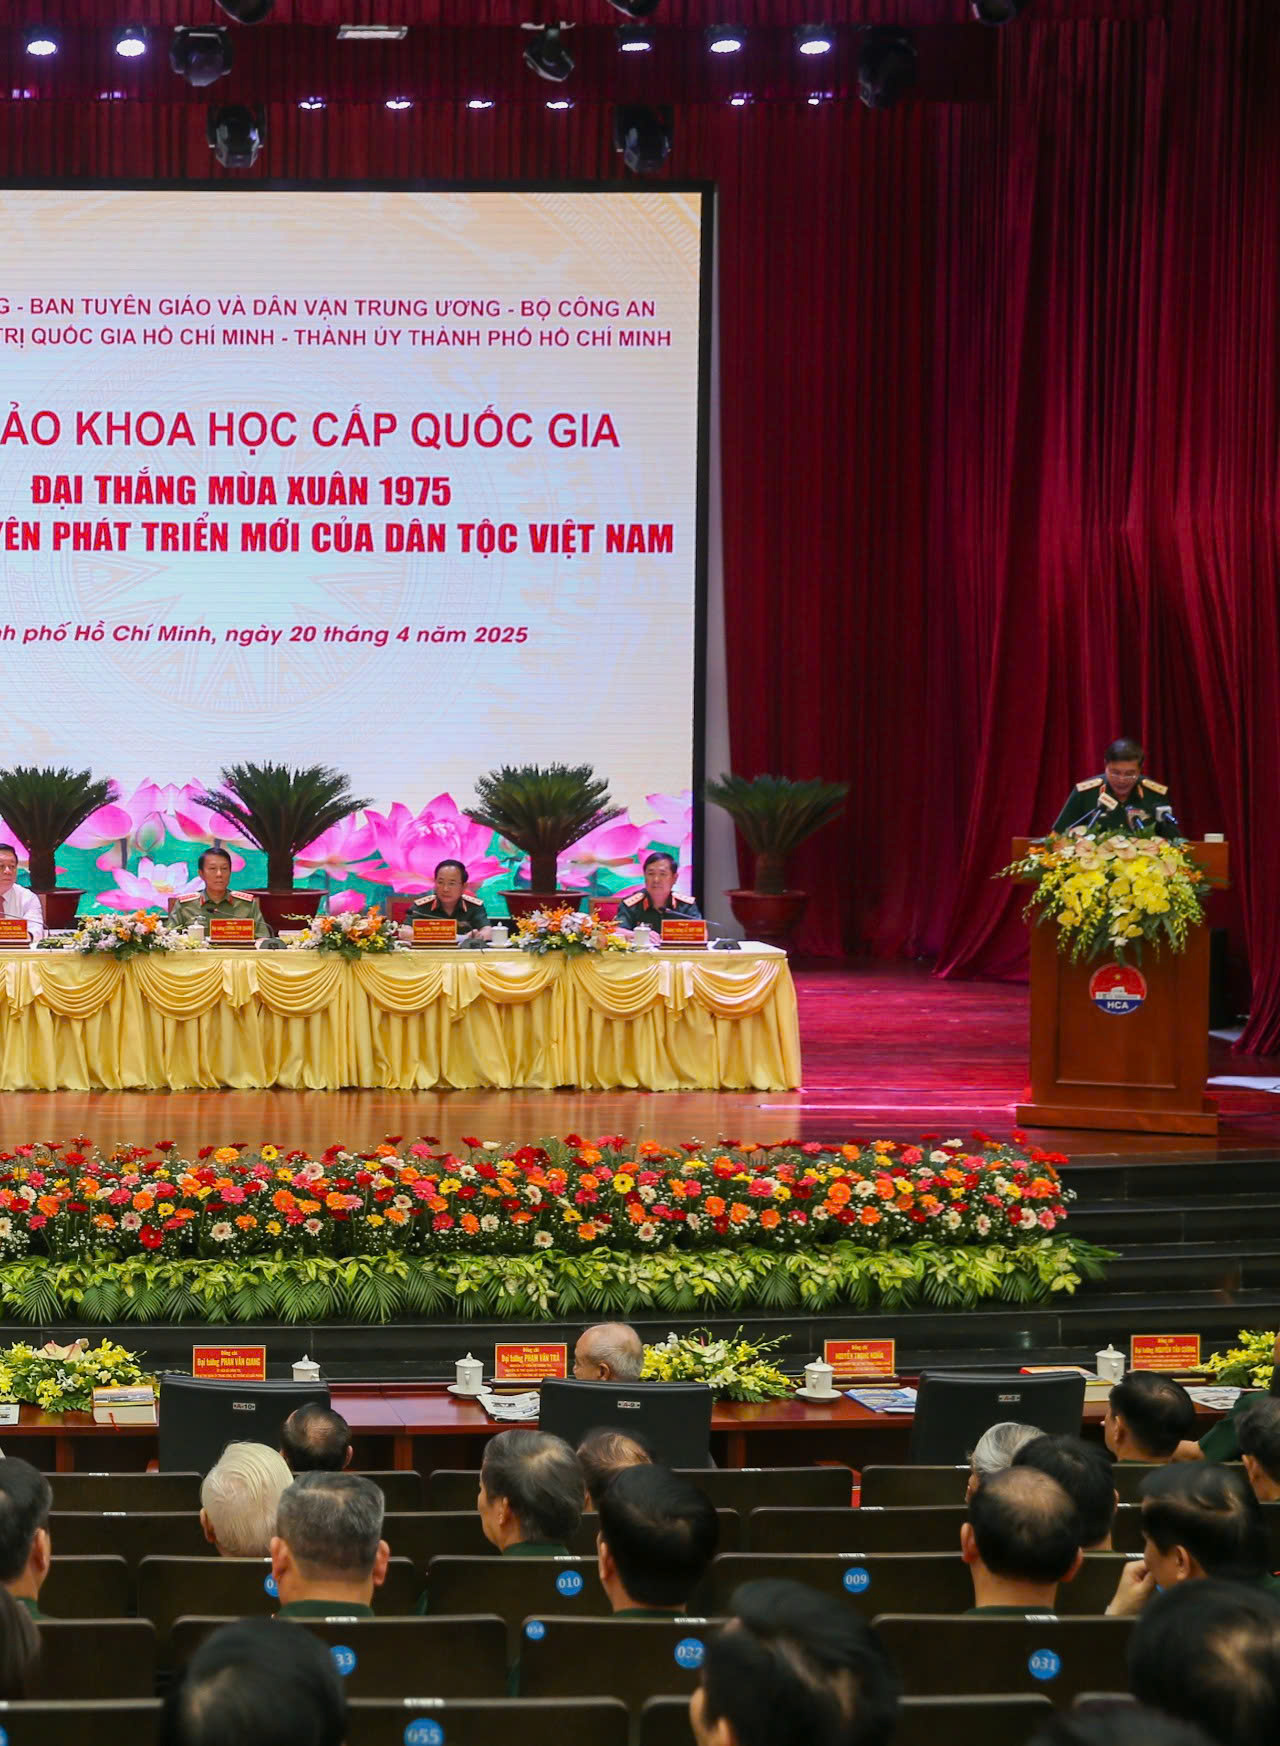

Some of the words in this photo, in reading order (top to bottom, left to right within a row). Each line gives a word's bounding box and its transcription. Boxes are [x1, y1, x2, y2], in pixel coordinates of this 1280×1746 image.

[31, 298, 73, 314] BAN
[81, 294, 150, 315] TUYÊN
[159, 295, 211, 315] GIÁO
[218, 295, 246, 315] VÀ
[254, 295, 296, 315] DÂN
[354, 300, 427, 316] TRUNG
[436, 300, 500, 317] ƯƠNG
[558, 296, 619, 317] CÔNG
[626, 301, 654, 317] AN
[101, 328, 136, 344] GIA
[180, 325, 214, 345] CHÍ
[223, 329, 274, 345] MINH
[294, 325, 366, 345] THÀNH
[408, 326, 480, 346] THÀNH
[577, 326, 611, 346] CHÍ
[619, 331, 670, 346] MINH
[76, 411, 196, 446] KHOA
[209, 412, 297, 455] HỌC
[312, 404, 397, 447] CẤP
[411, 404, 532, 450] QUỐC
[548, 413, 620, 448] GIA
[31, 475, 82, 510] ĐẠI
[94, 467, 196, 505] THẮNG
[208, 471, 277, 505] MÙA
[287, 471, 368, 505] XUÂN
[379, 476, 451, 506] 1975
[53, 517, 132, 551] PHÁT
[141, 512, 228, 552] TRIỂN
[241, 517, 299, 552] MỚI
[312, 516, 374, 553] CỦA
[385, 518, 446, 552] DÂN
[457, 518, 518, 559] TỘC
[529, 519, 595, 559] VIỆT
[606, 524, 673, 553] NAM
[23, 620, 71, 644] phố
[74, 620, 105, 642] Hồ
[113, 624, 153, 642] Chí
[158, 626, 216, 644] Minh,
[225, 624, 283, 646] ngày
[289, 626, 316, 642] 20
[324, 625, 389, 646] tháng
[396, 626, 410, 642] 4
[417, 626, 466, 643] năm
[474, 627, 528, 643] 2025
[1107, 1001, 1129, 1009] HCA
[558, 1576, 580, 1588] 010
[845, 1574, 867, 1585] 009
[334, 1652, 352, 1667] 33
[677, 1645, 703, 1659] 032
[1031, 1656, 1056, 1672] 031
